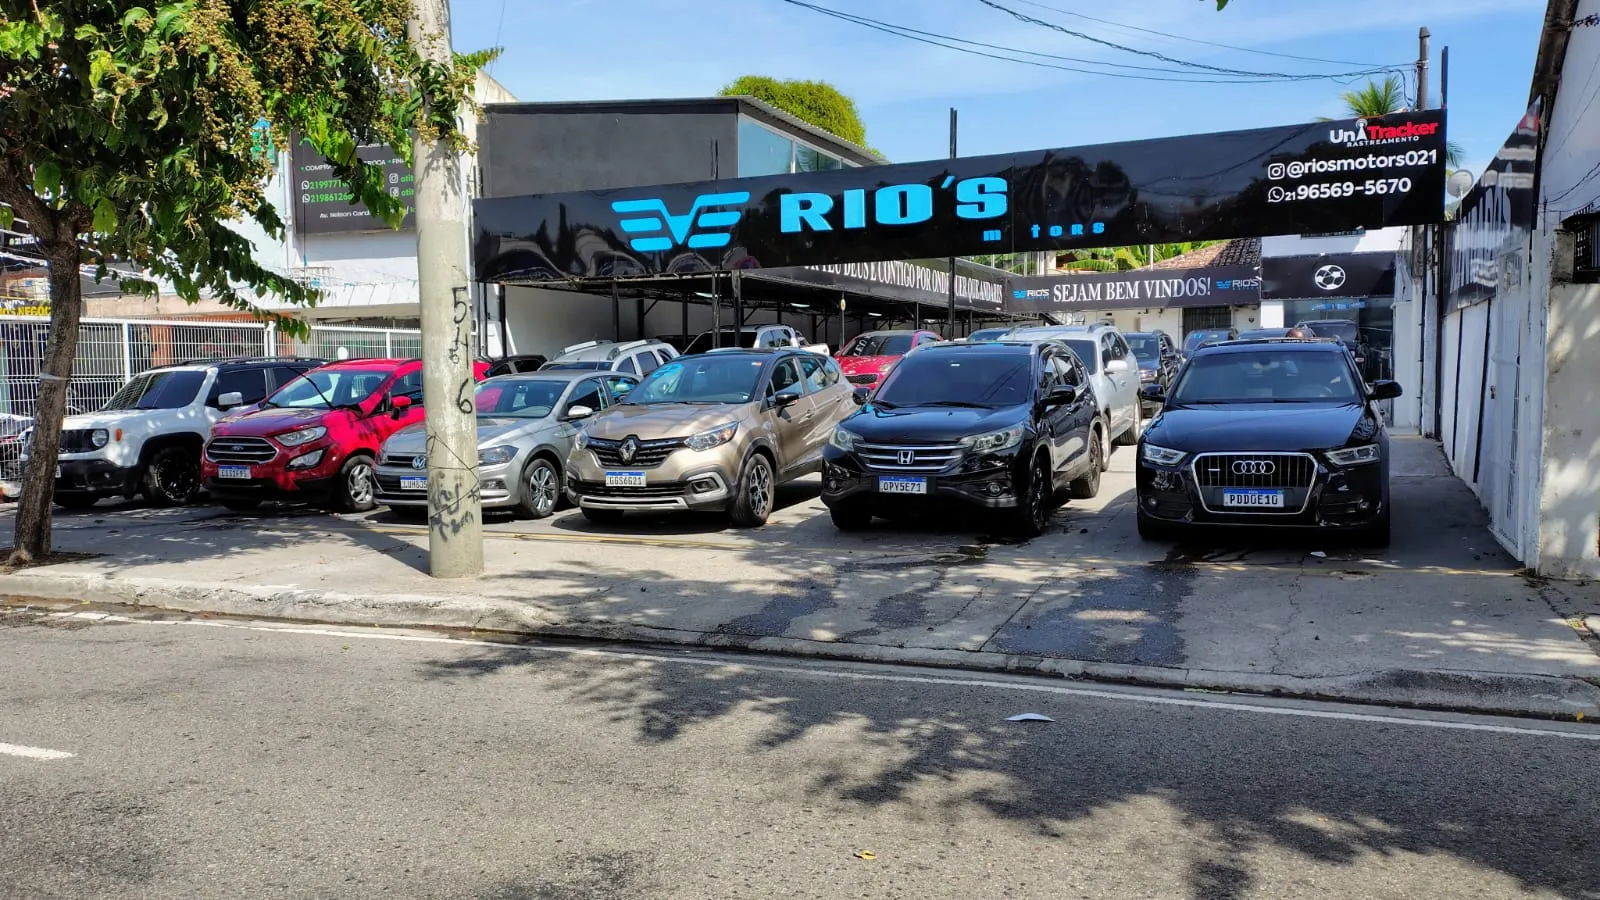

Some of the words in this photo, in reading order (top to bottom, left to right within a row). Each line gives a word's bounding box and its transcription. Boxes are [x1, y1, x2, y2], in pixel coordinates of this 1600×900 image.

[1346, 136, 1420, 148] RASTREAMENTO
[1287, 149, 1438, 179] @riosmotors021
[1297, 177, 1412, 200] 96569-5670
[780, 176, 1008, 233] RIO'S
[1053, 283, 1102, 303] SEJAM
[1105, 281, 1140, 301] BEM
[1145, 277, 1212, 299] VINDOS!
